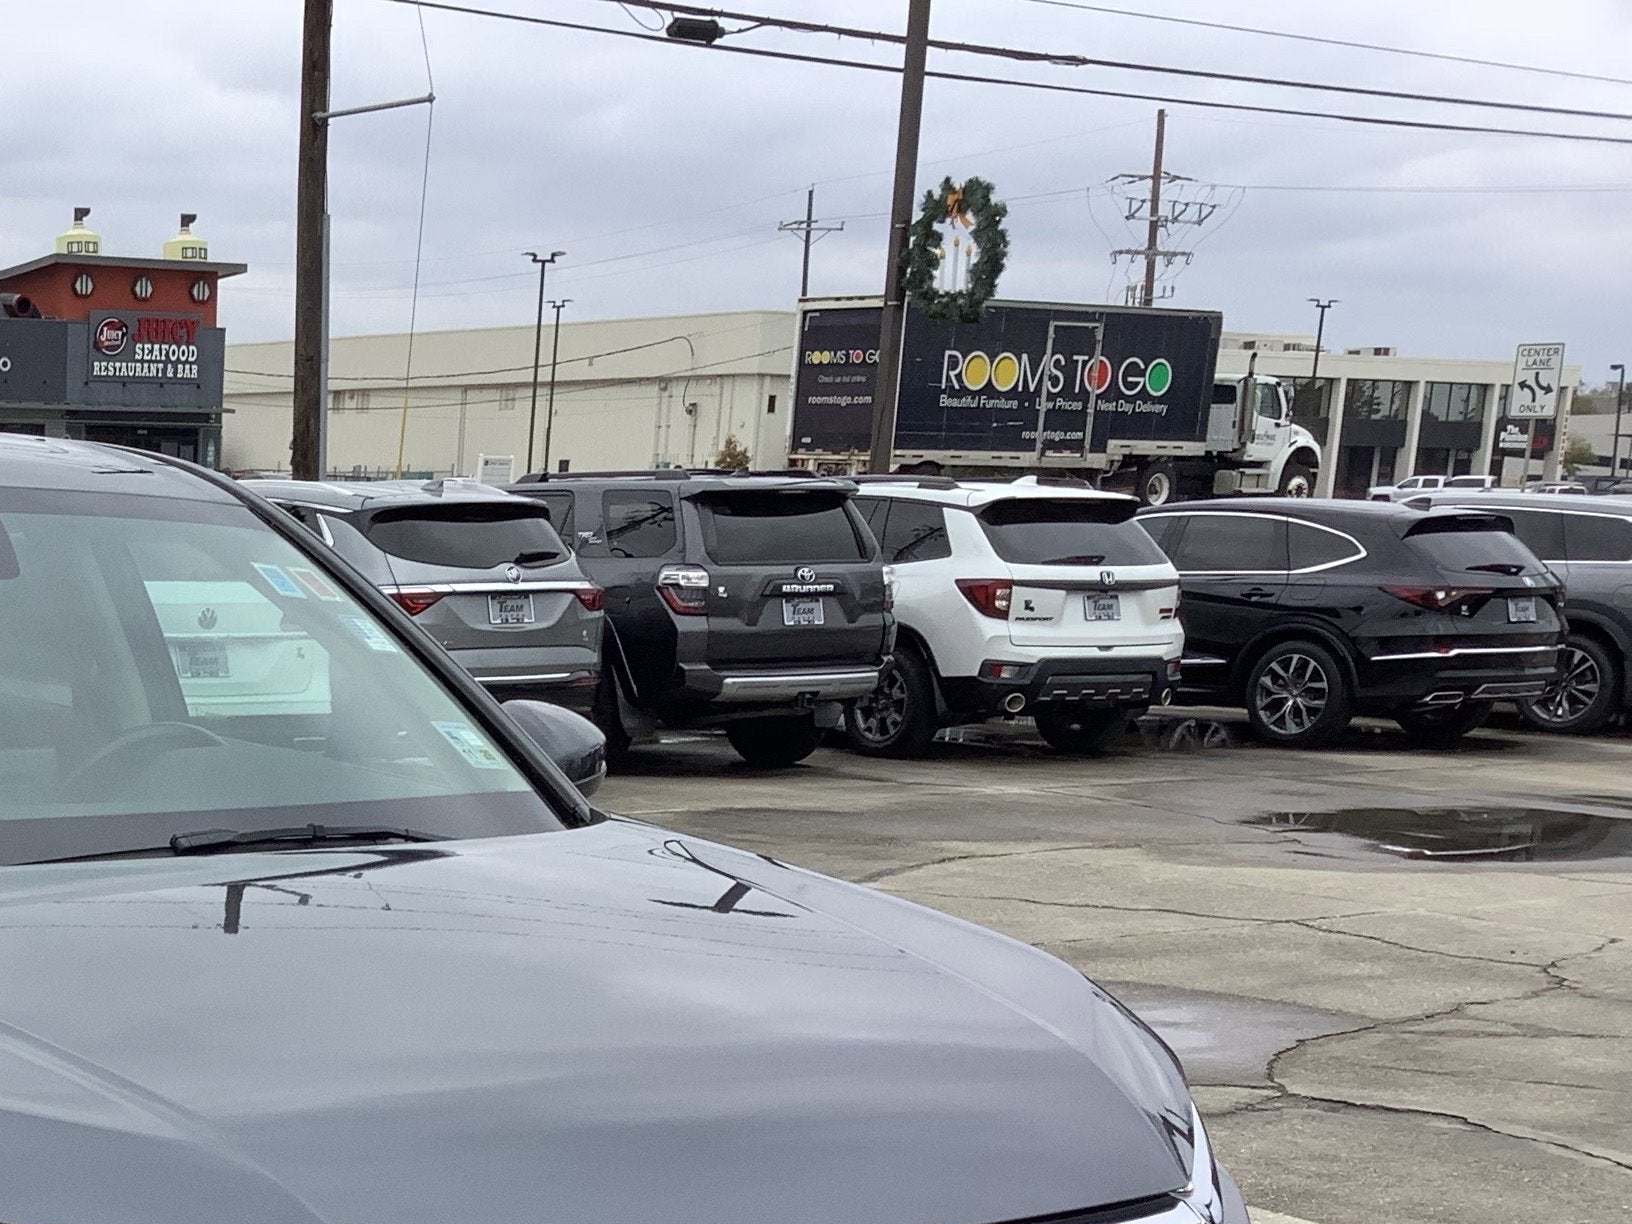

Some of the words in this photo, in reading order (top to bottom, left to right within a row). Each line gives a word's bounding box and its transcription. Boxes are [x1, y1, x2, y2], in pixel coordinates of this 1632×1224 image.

[131, 317, 198, 344] JUICY
[134, 343, 198, 361] SEAFOOD
[804, 350, 846, 364] ROOMS
[849, 349, 864, 364] TO
[1521, 347, 1560, 358] CENTER
[93, 361, 164, 377] RESTAURANT
[166, 363, 175, 377] &
[177, 364, 198, 378] BAR
[1526, 358, 1552, 367] LANE
[941, 350, 1065, 394] ROOMS
[1073, 355, 1112, 394] TO
[1118, 356, 1172, 396] GO
[808, 395, 872, 407] roomstogo.com
[939, 394, 979, 408] Beautiful
[979, 395, 1019, 409] Furniture
[1035, 397, 1054, 410] Lw
[1055, 397, 1083, 410] Prices
[1097, 399, 1116, 411] Next
[1117, 400, 1134, 415] Day
[1135, 400, 1168, 416] Delivery
[1519, 404, 1546, 413] ONLY
[497, 600, 524, 613] TEAM
[791, 604, 815, 615] TEAM
